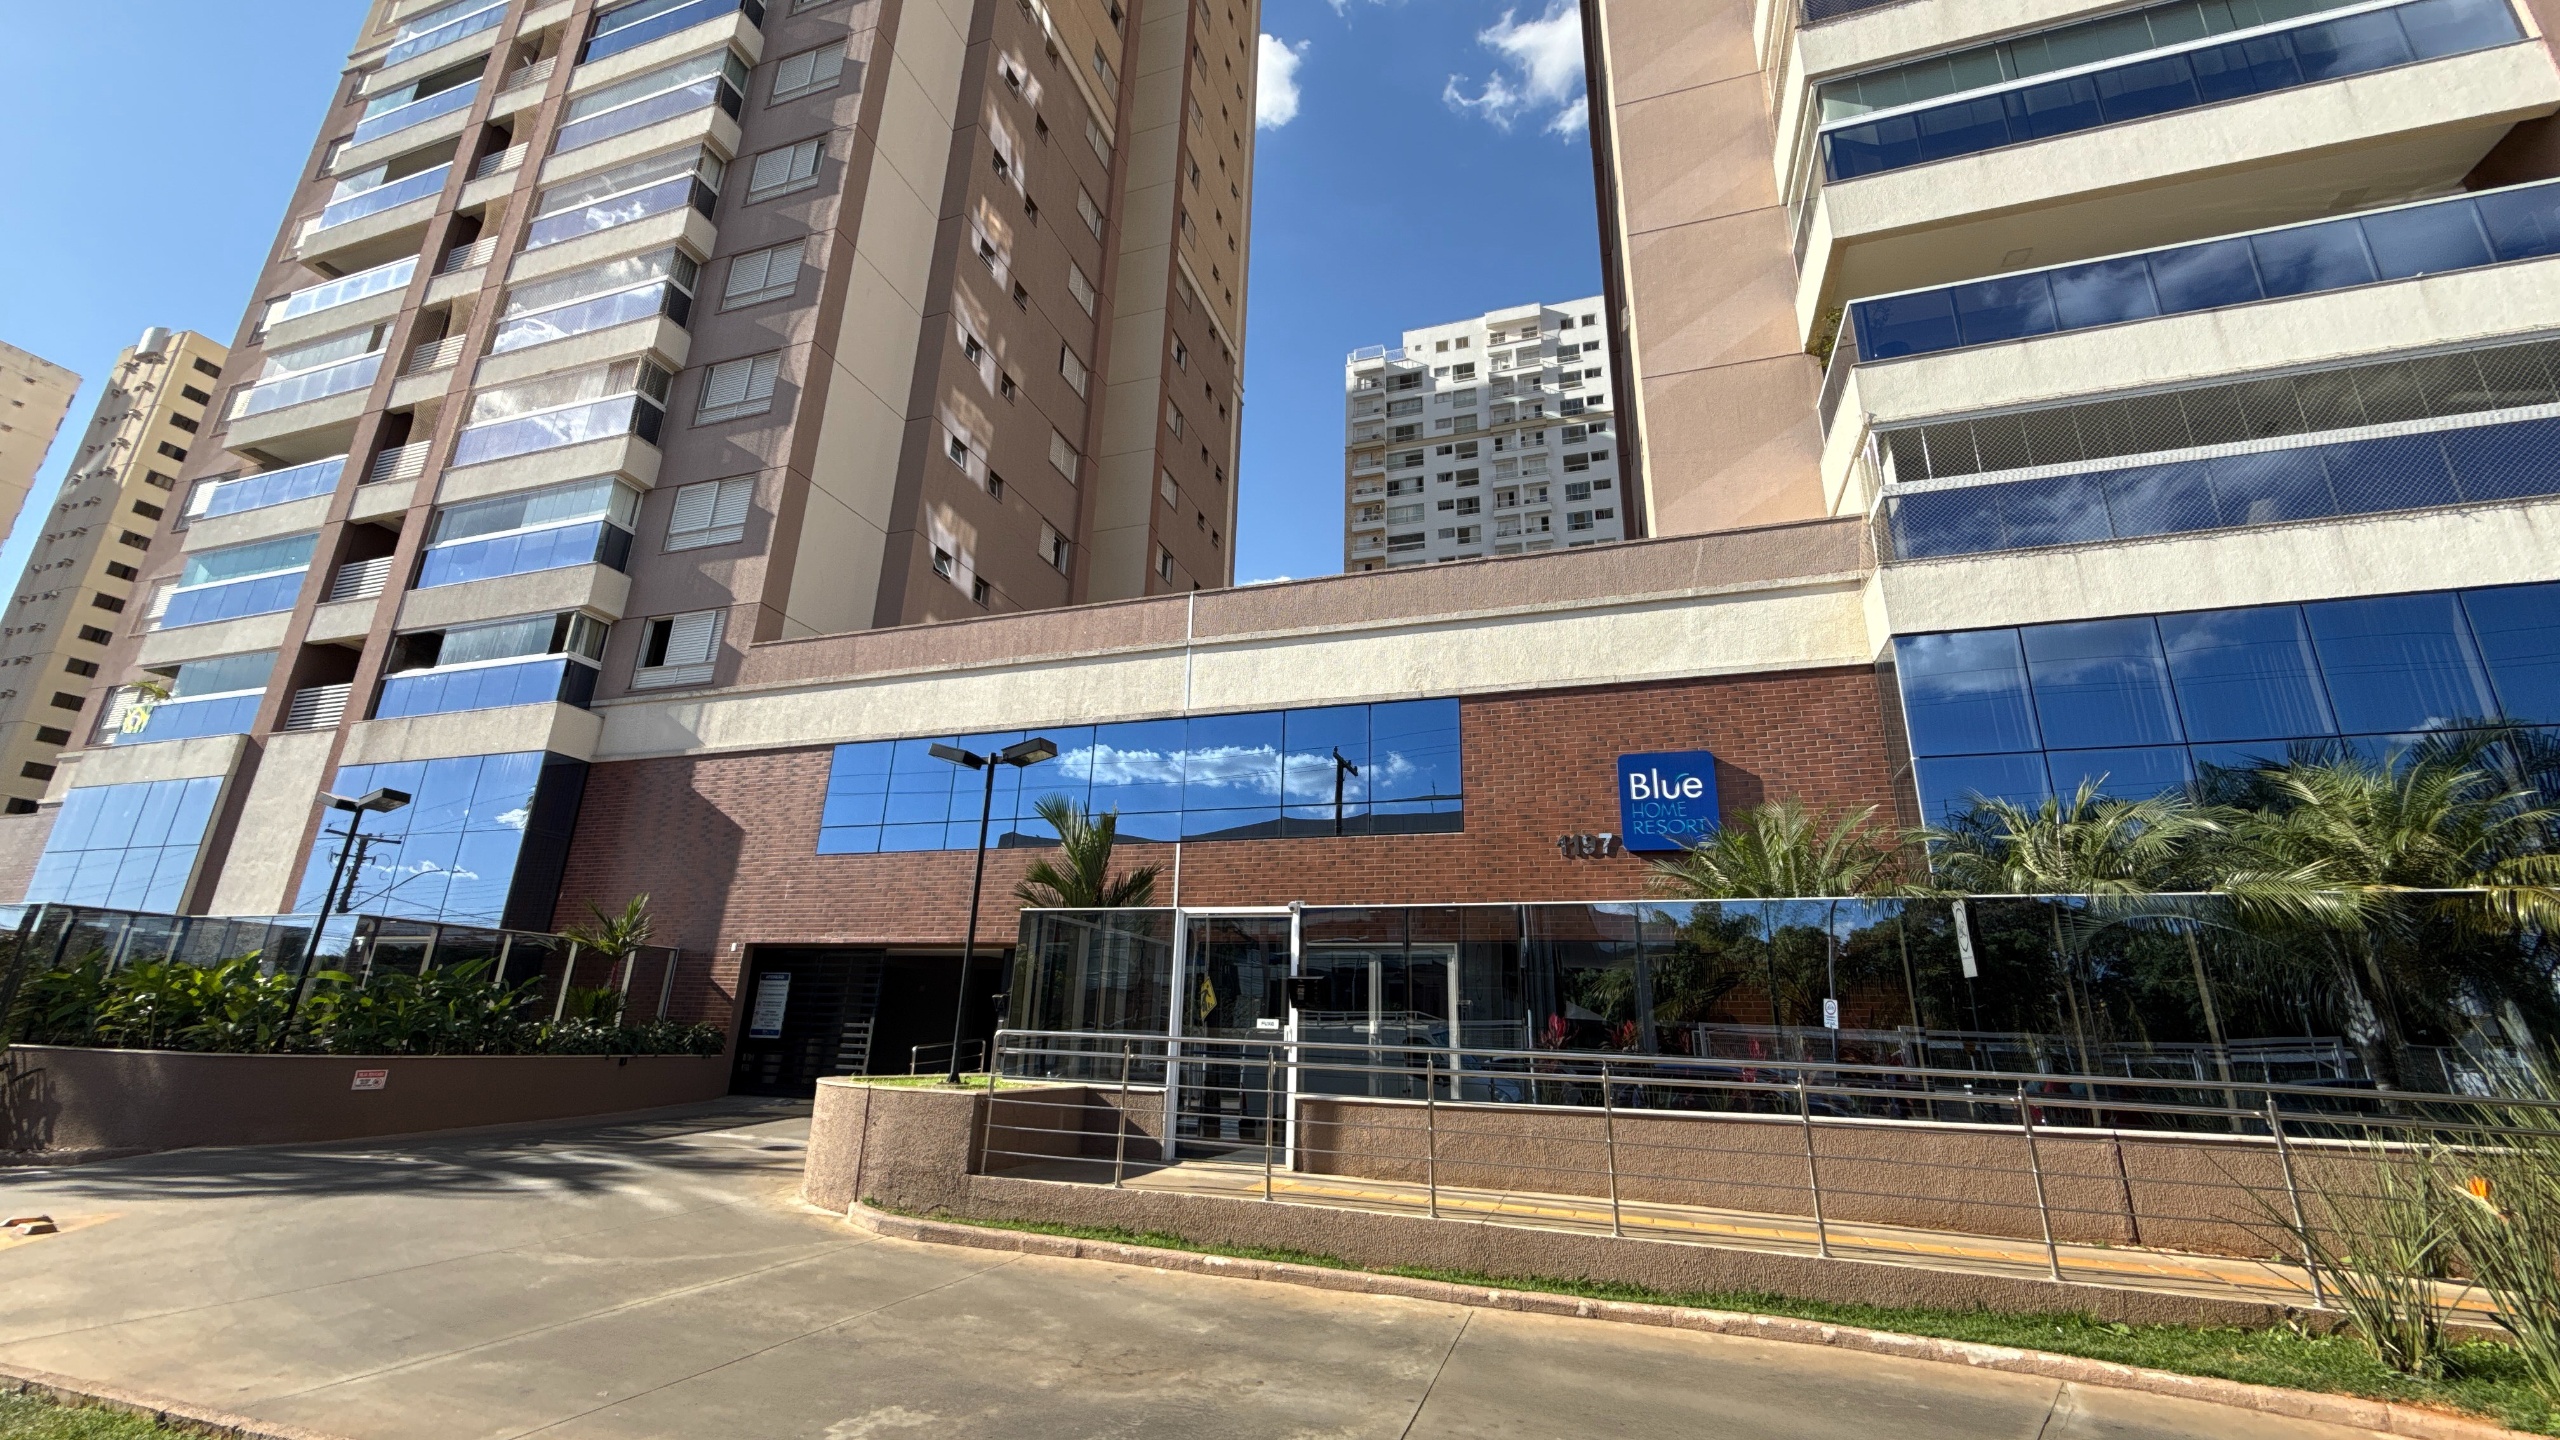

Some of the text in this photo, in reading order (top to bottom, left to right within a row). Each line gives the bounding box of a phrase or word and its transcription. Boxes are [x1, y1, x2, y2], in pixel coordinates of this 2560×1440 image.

[1629, 767, 1703, 800] Blue
[1632, 801, 1687, 818] HOME
[1633, 818, 1706, 835] RESORT
[1556, 833, 1612, 855] 1197
